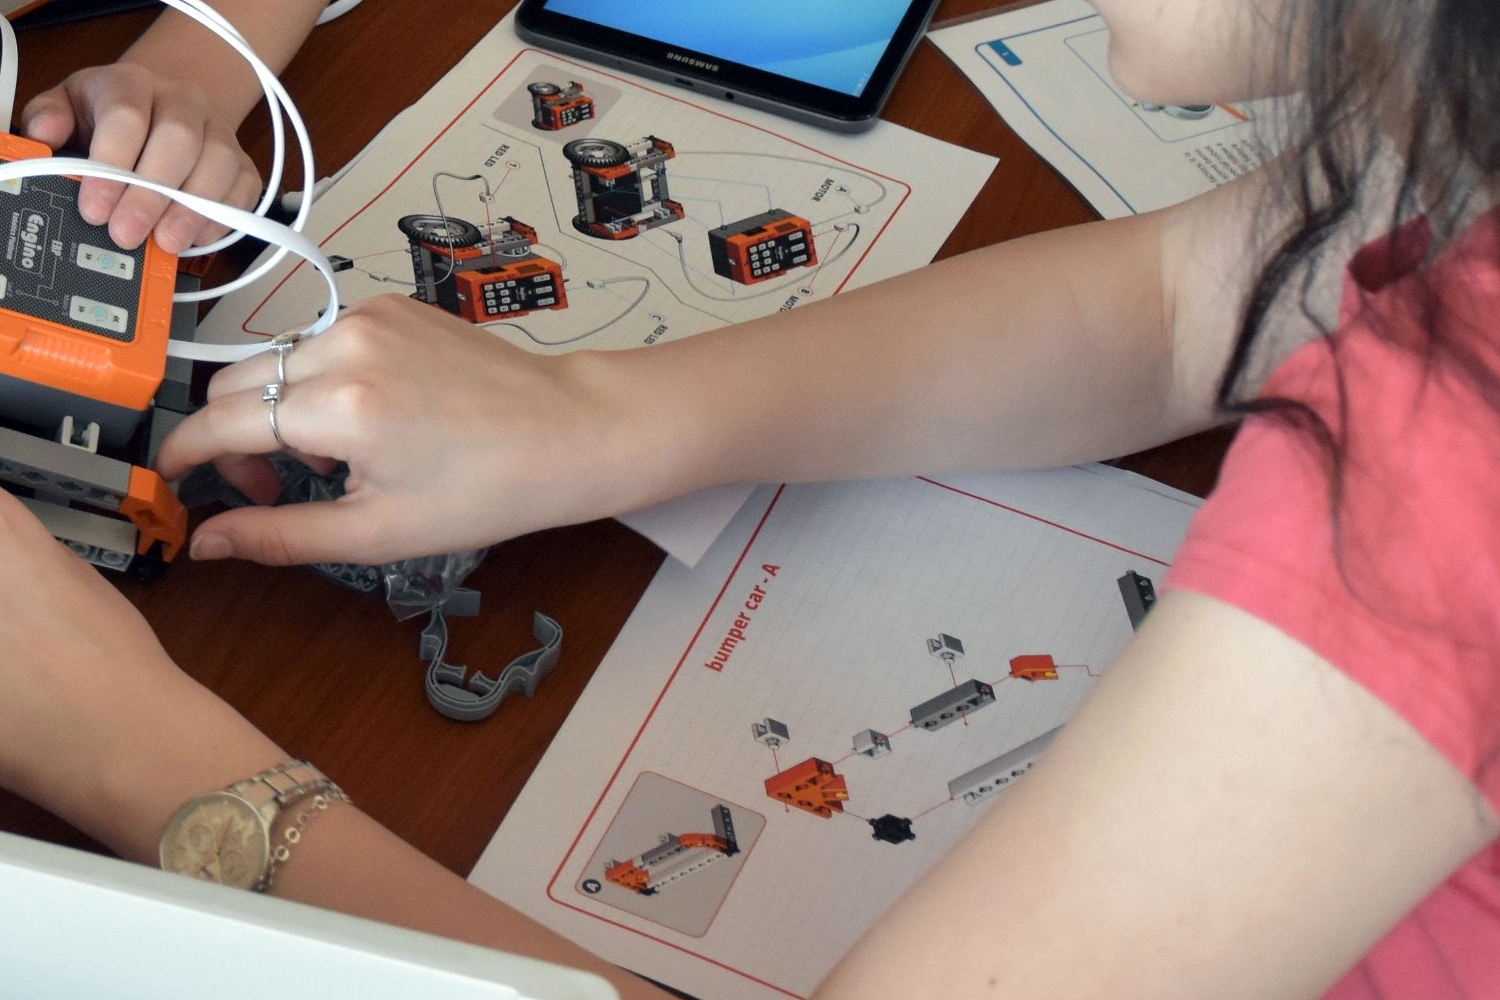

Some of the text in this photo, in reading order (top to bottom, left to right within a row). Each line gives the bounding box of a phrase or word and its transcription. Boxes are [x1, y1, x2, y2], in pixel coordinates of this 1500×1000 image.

[666, 52, 720, 72] SAMSUNG
[484, 144, 510, 167] RED LED
[811, 177, 834, 202] MOTOR
[21, 213, 45, 269] Engino
[52, 241, 63, 256] ERP
[704, 611, 751, 673] bumper
[744, 584, 766, 611] car
[761, 563, 781, 578] A
